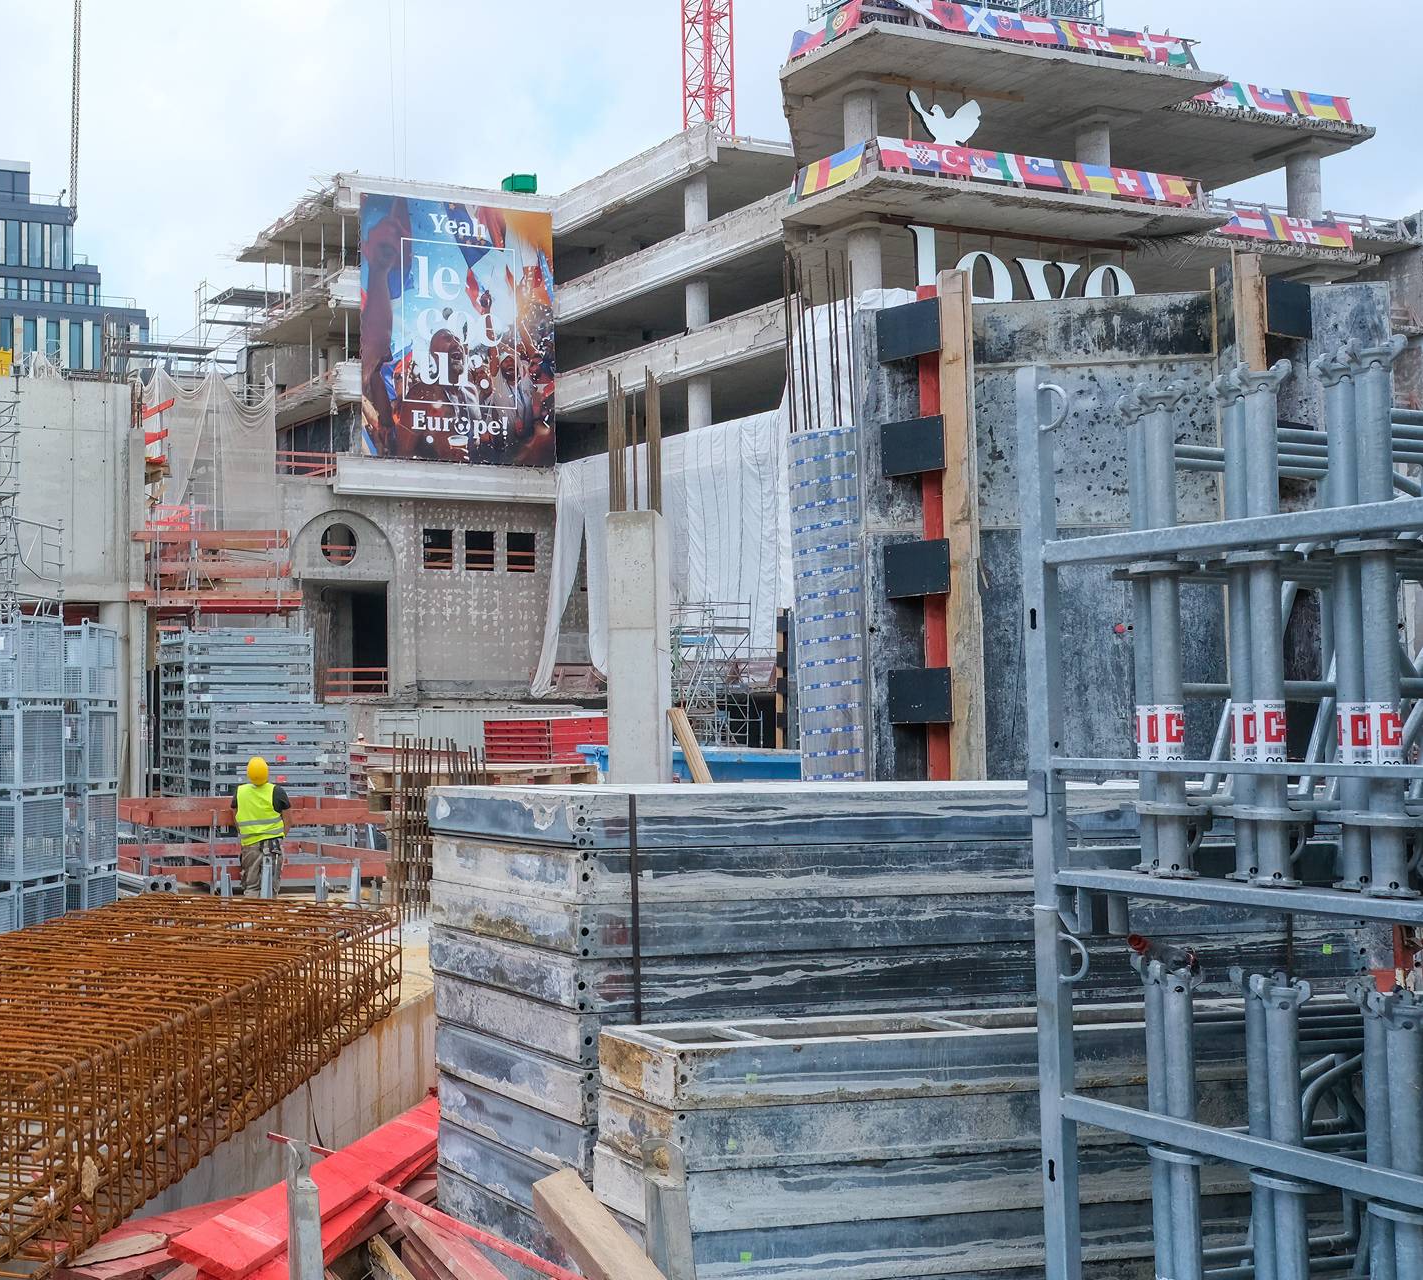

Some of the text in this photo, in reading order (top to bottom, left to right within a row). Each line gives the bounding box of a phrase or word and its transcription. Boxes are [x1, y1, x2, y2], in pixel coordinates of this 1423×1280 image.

[429, 213, 487, 239] Yeah
[414, 254, 461, 301] le
[411, 408, 508, 439] Europe!
